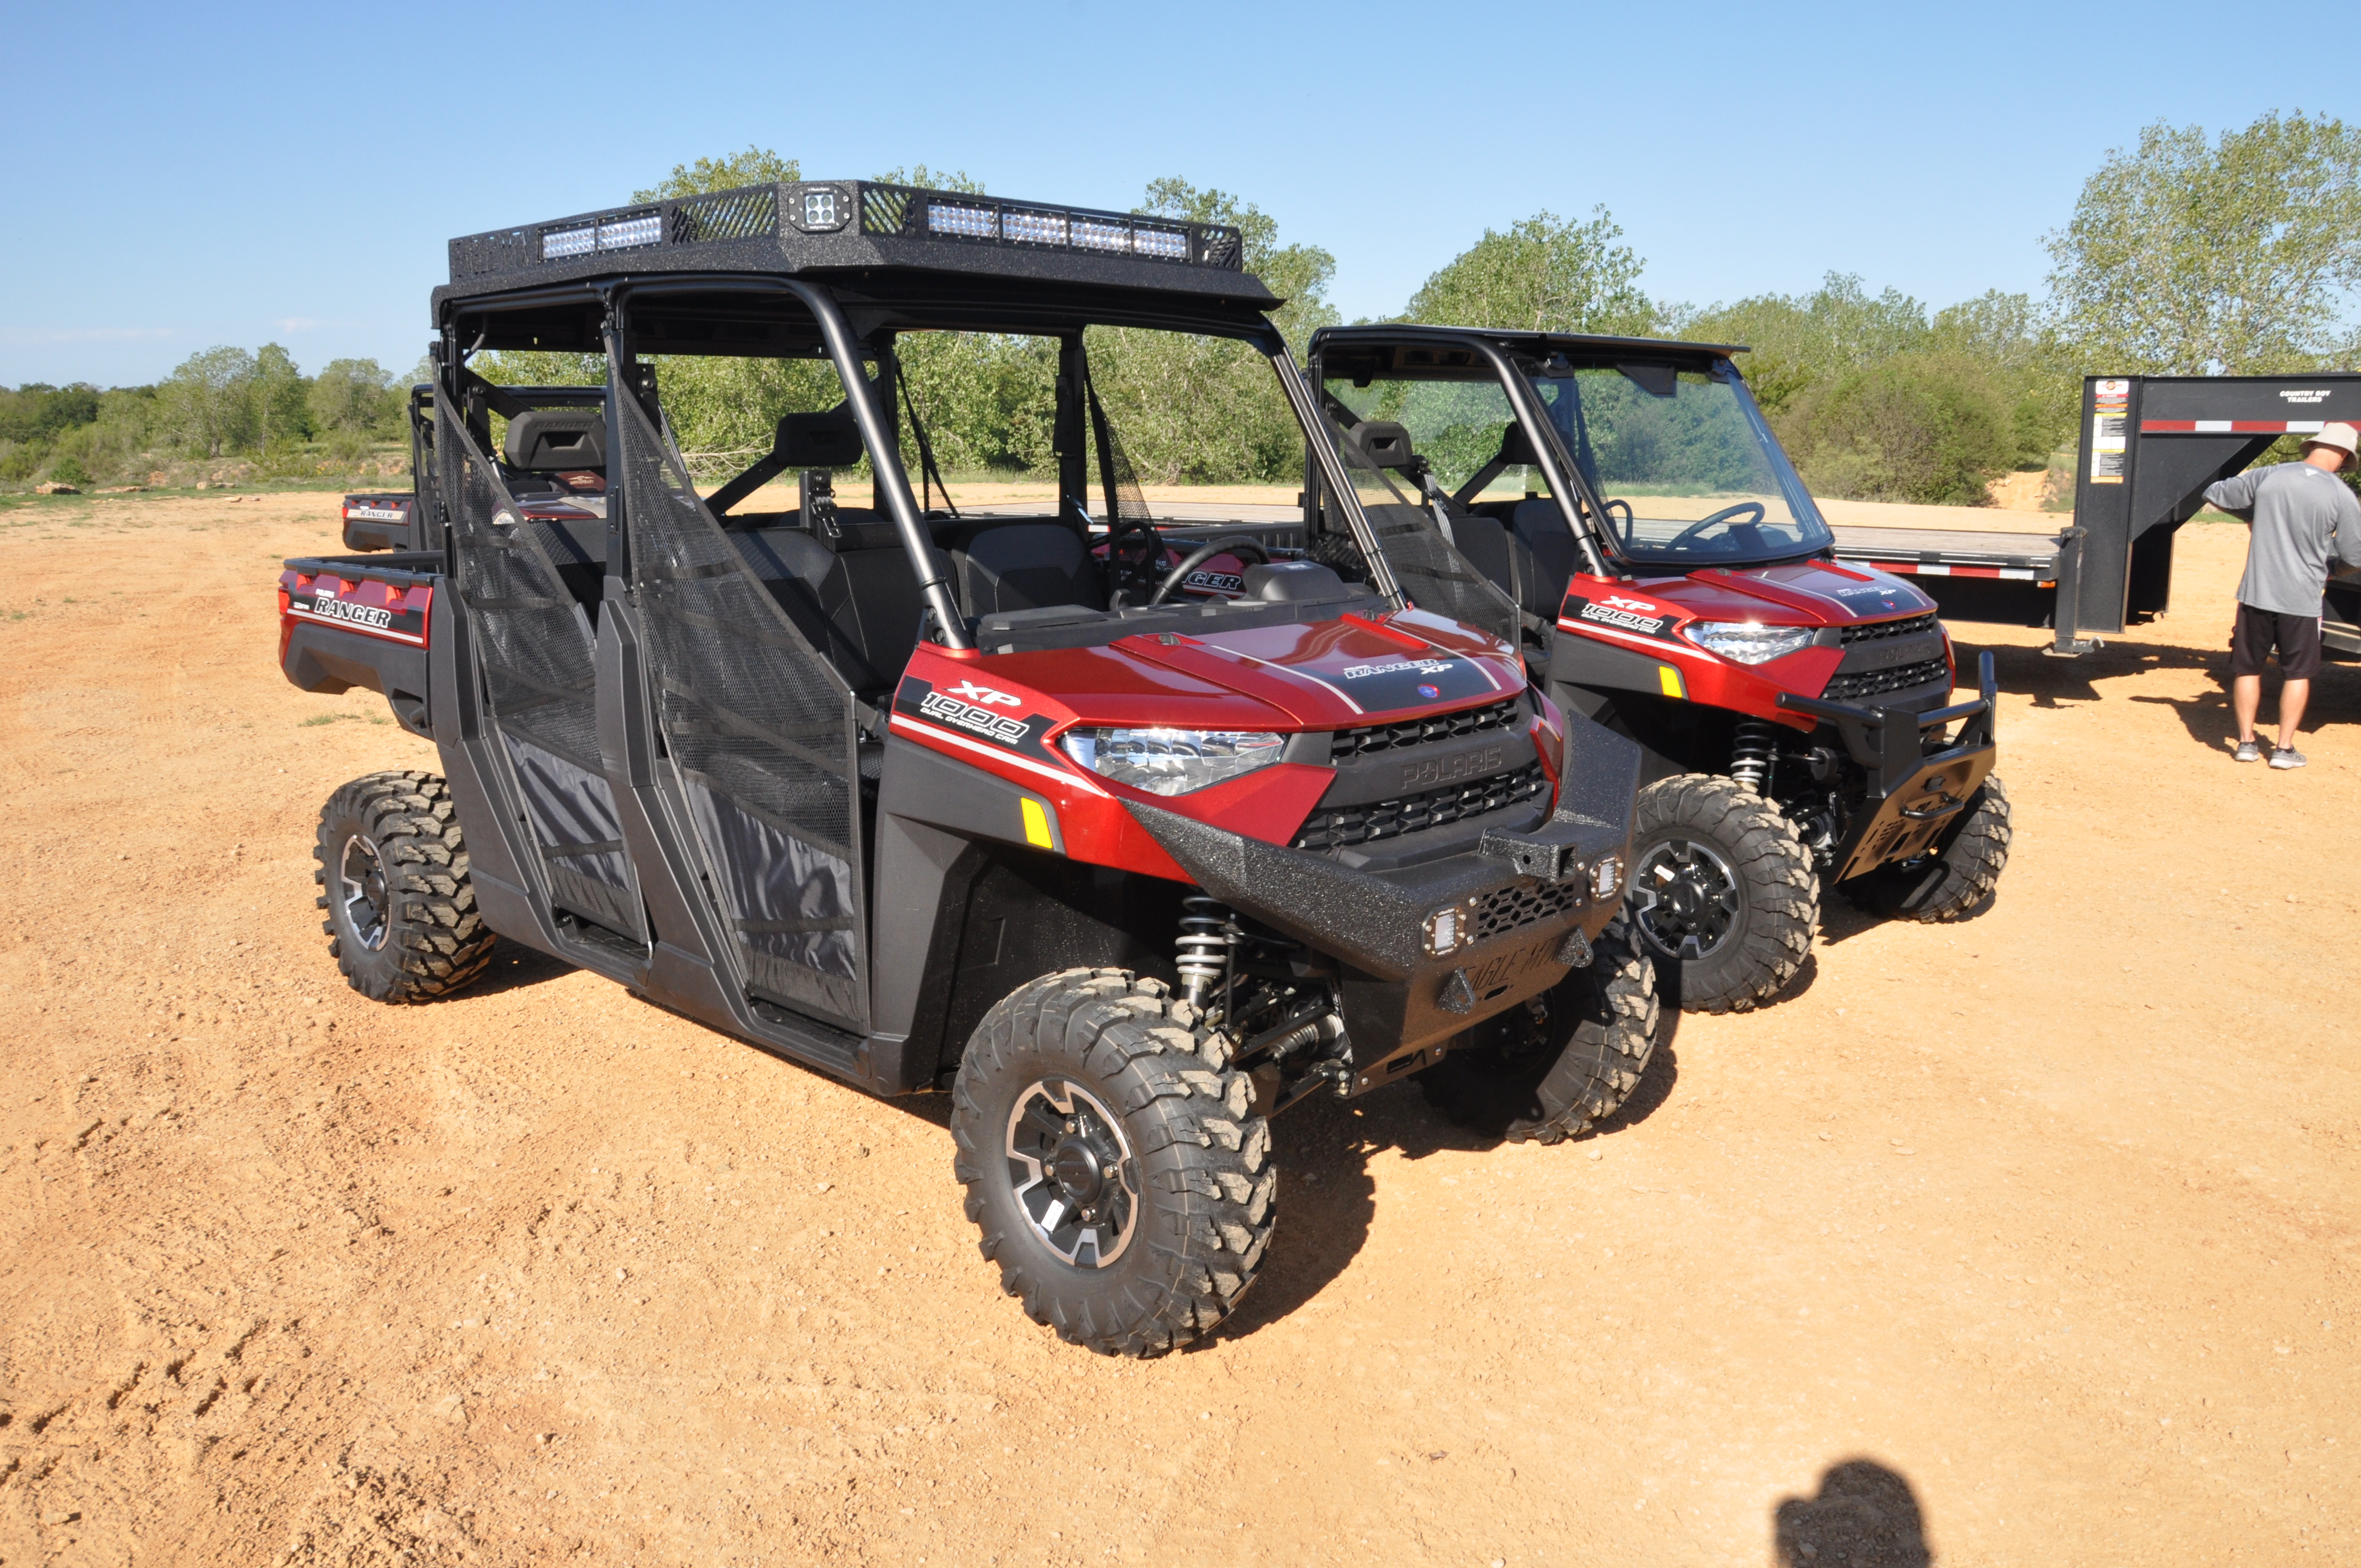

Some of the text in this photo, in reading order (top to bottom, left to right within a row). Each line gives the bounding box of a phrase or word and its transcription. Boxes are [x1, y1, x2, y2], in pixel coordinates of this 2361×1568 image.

[1182, 571, 1241, 590] GER
[314, 597, 391, 628] RANGER
[1581, 603, 1664, 630] 1000
[1600, 595, 1656, 611] XP
[1600, 618, 1639, 630] OVERHEAD
[1343, 659, 1440, 679] RANGER
[1419, 663, 1454, 674] XP
[946, 679, 1022, 707] XP
[920, 707, 1018, 745] DUAL OVERHEAD CAM
[921, 692, 1030, 739] 1000
[1401, 745, 1502, 790] POLARIS
